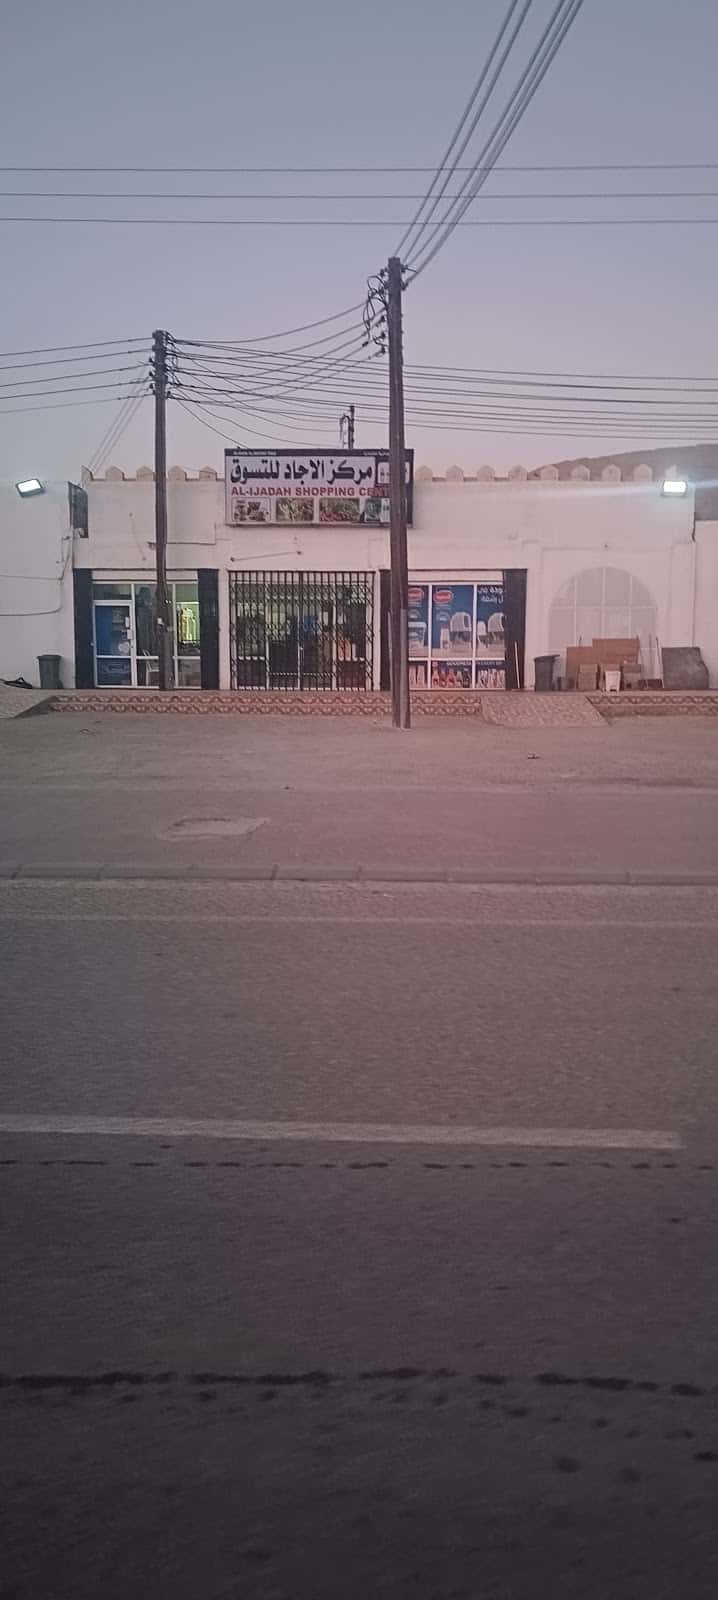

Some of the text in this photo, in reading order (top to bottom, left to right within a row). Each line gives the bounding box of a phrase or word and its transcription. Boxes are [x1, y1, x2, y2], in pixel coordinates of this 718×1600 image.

[230, 459, 280, 484] للتسوق
[327, 459, 373, 485] مركز
[231, 486, 292, 496] AL-IJADAH
[295, 487, 355, 497] SHOPPING
